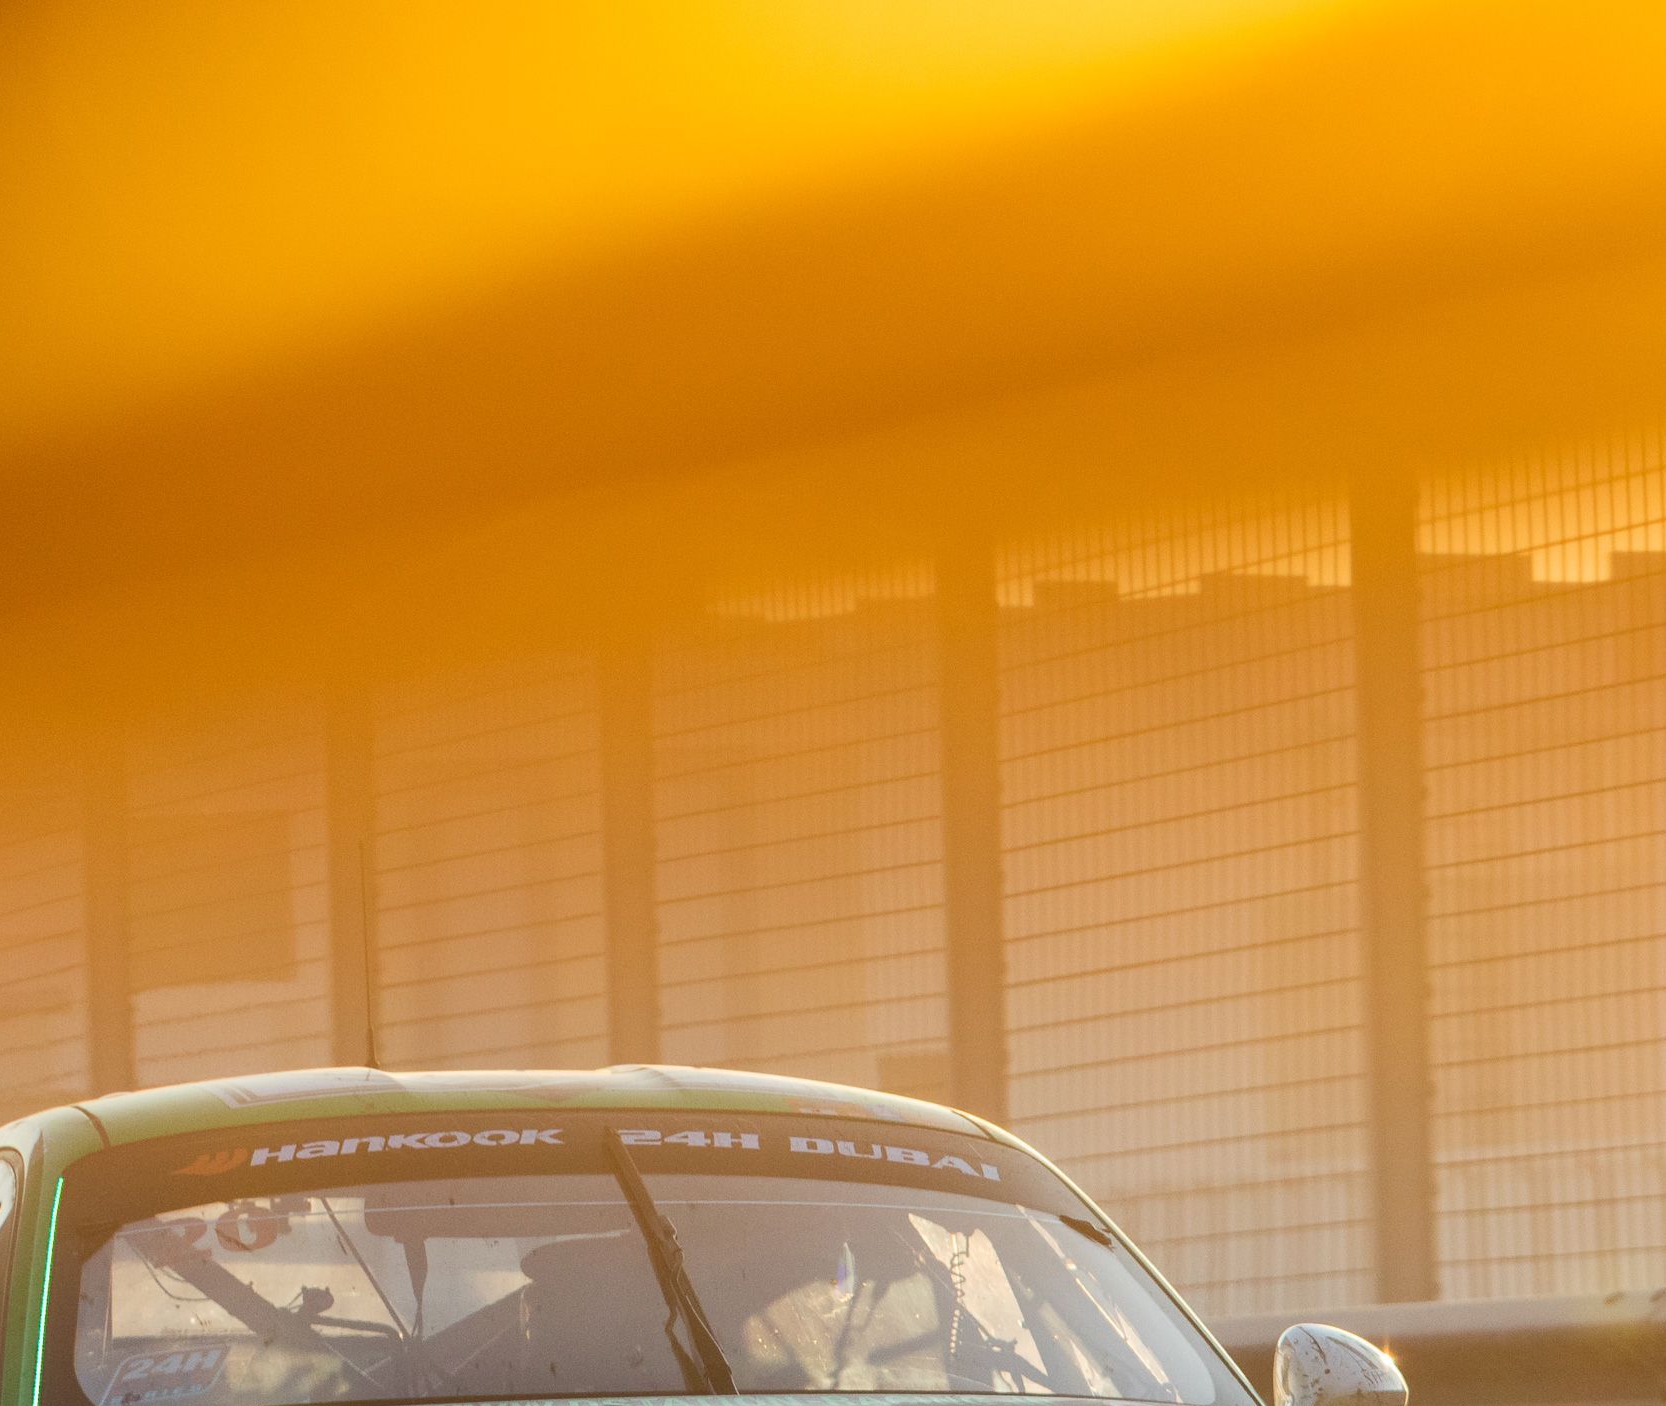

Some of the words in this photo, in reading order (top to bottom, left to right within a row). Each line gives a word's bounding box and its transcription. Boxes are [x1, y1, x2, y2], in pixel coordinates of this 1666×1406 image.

[618, 1129, 761, 1151] 24H
[788, 1135, 1002, 1182] DUBAI
[122, 1348, 223, 1382] 24H
